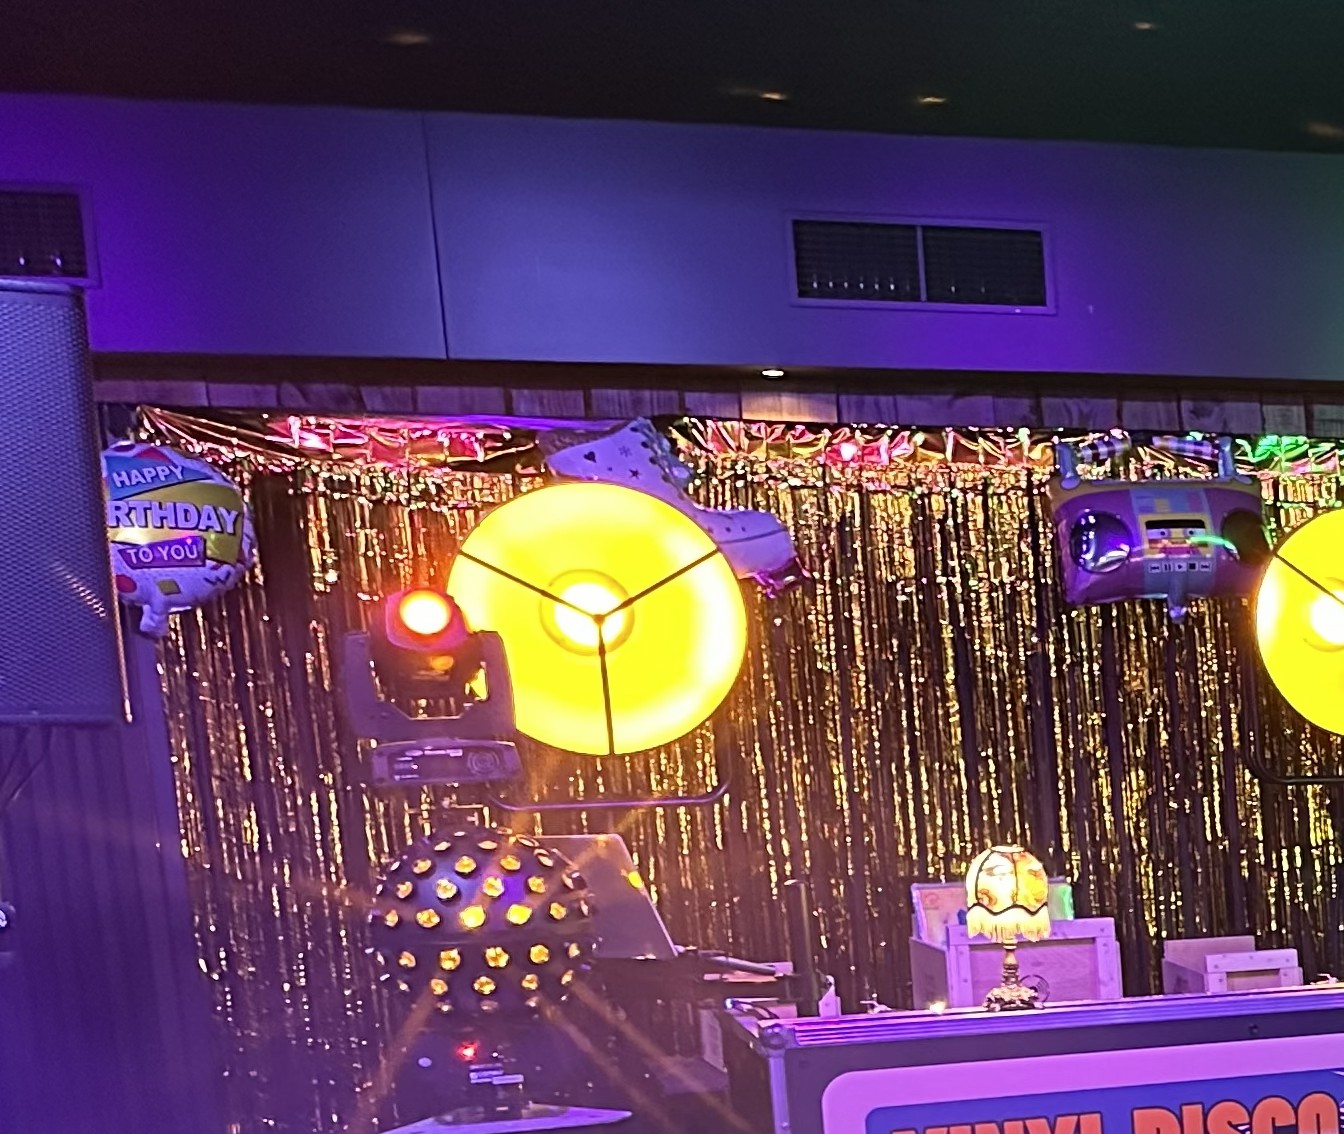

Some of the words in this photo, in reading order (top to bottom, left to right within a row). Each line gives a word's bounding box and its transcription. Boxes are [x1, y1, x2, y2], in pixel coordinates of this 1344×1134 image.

[112, 465, 185, 488] HAPPY
[108, 500, 239, 535] RTHDAY
[126, 547, 153, 564] TO
[158, 544, 198, 561] YOU
